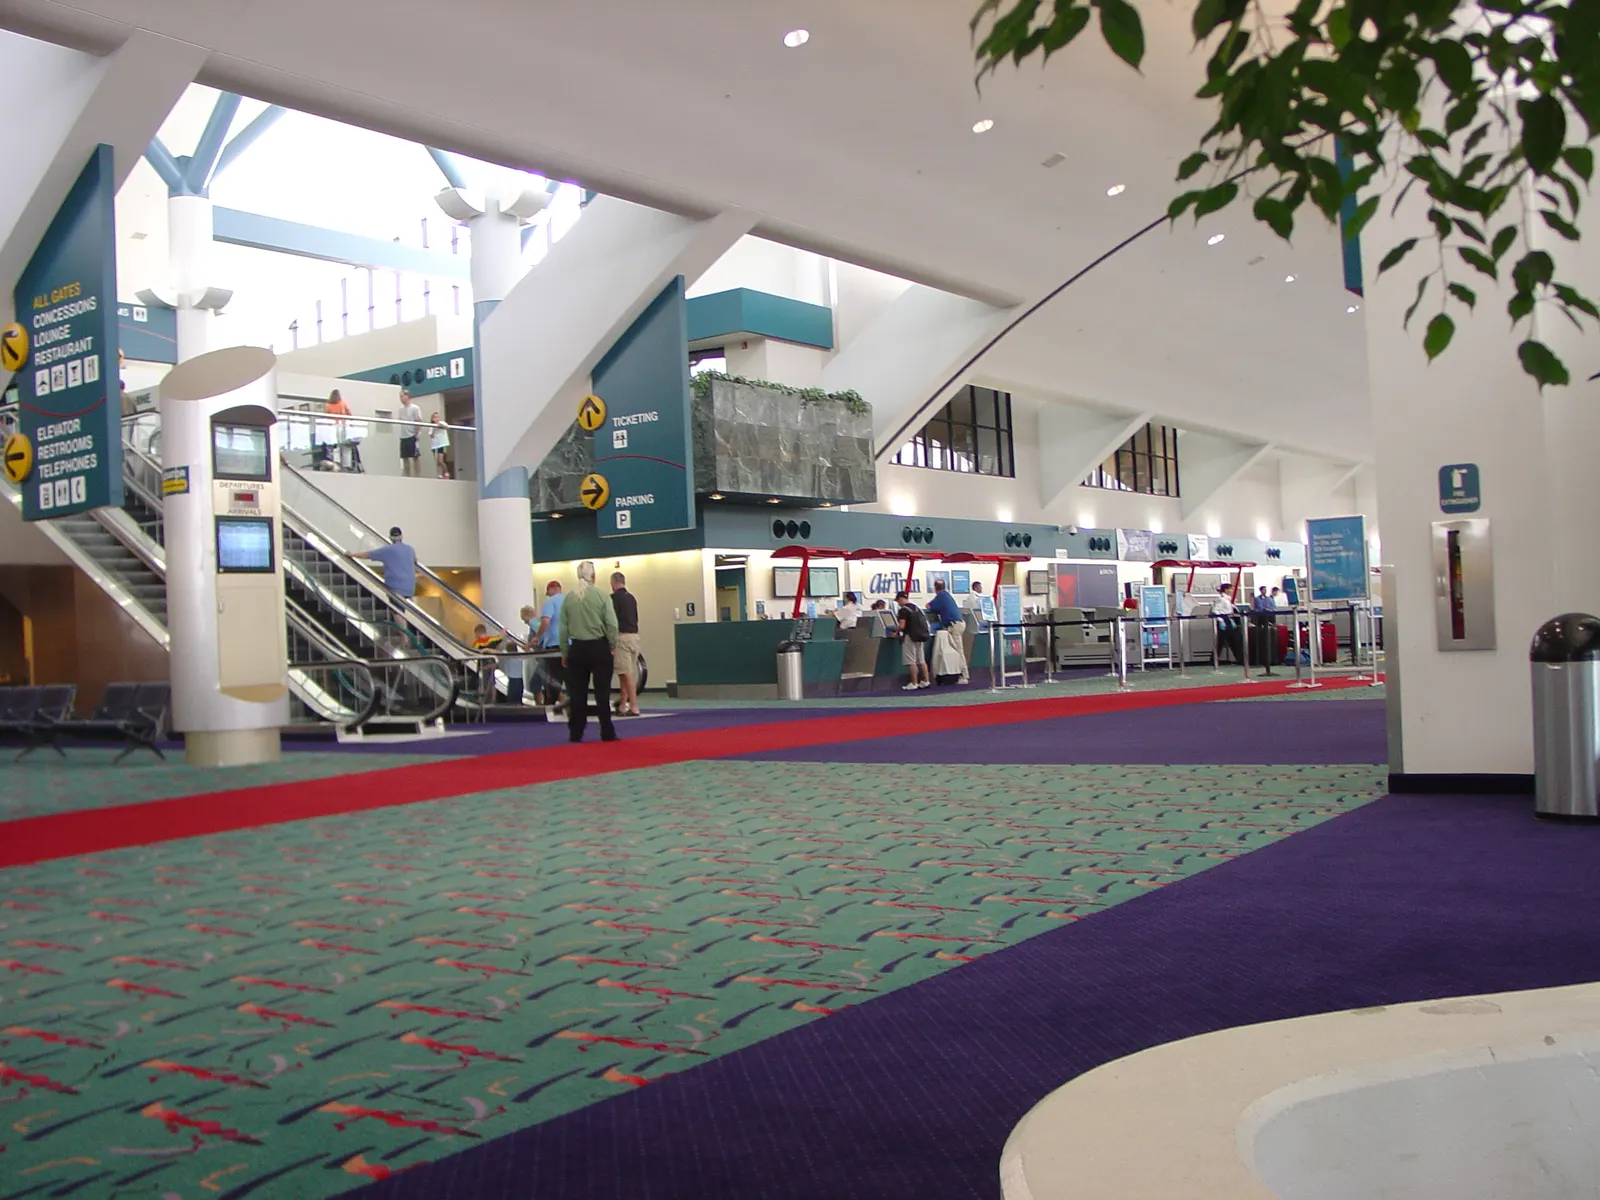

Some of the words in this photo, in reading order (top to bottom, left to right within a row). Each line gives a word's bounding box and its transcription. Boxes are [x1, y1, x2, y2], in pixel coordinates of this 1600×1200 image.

[32, 293, 50, 309] ALL
[51, 281, 81, 302] GATES
[33, 296, 97, 328] CONCESSIONS
[34, 324, 71, 347] LOUNGE
[34, 336, 94, 366] RESTAURANT
[426, 366, 447, 379] MEN
[37, 418, 81, 441] ELEVATOR
[612, 411, 659, 427] TICKETING
[38, 435, 94, 460] RESTROOMS
[38, 453, 97, 478] TELEPHONES
[219, 482, 264, 490] DEPARTURES
[615, 493, 654, 507] PARKING
